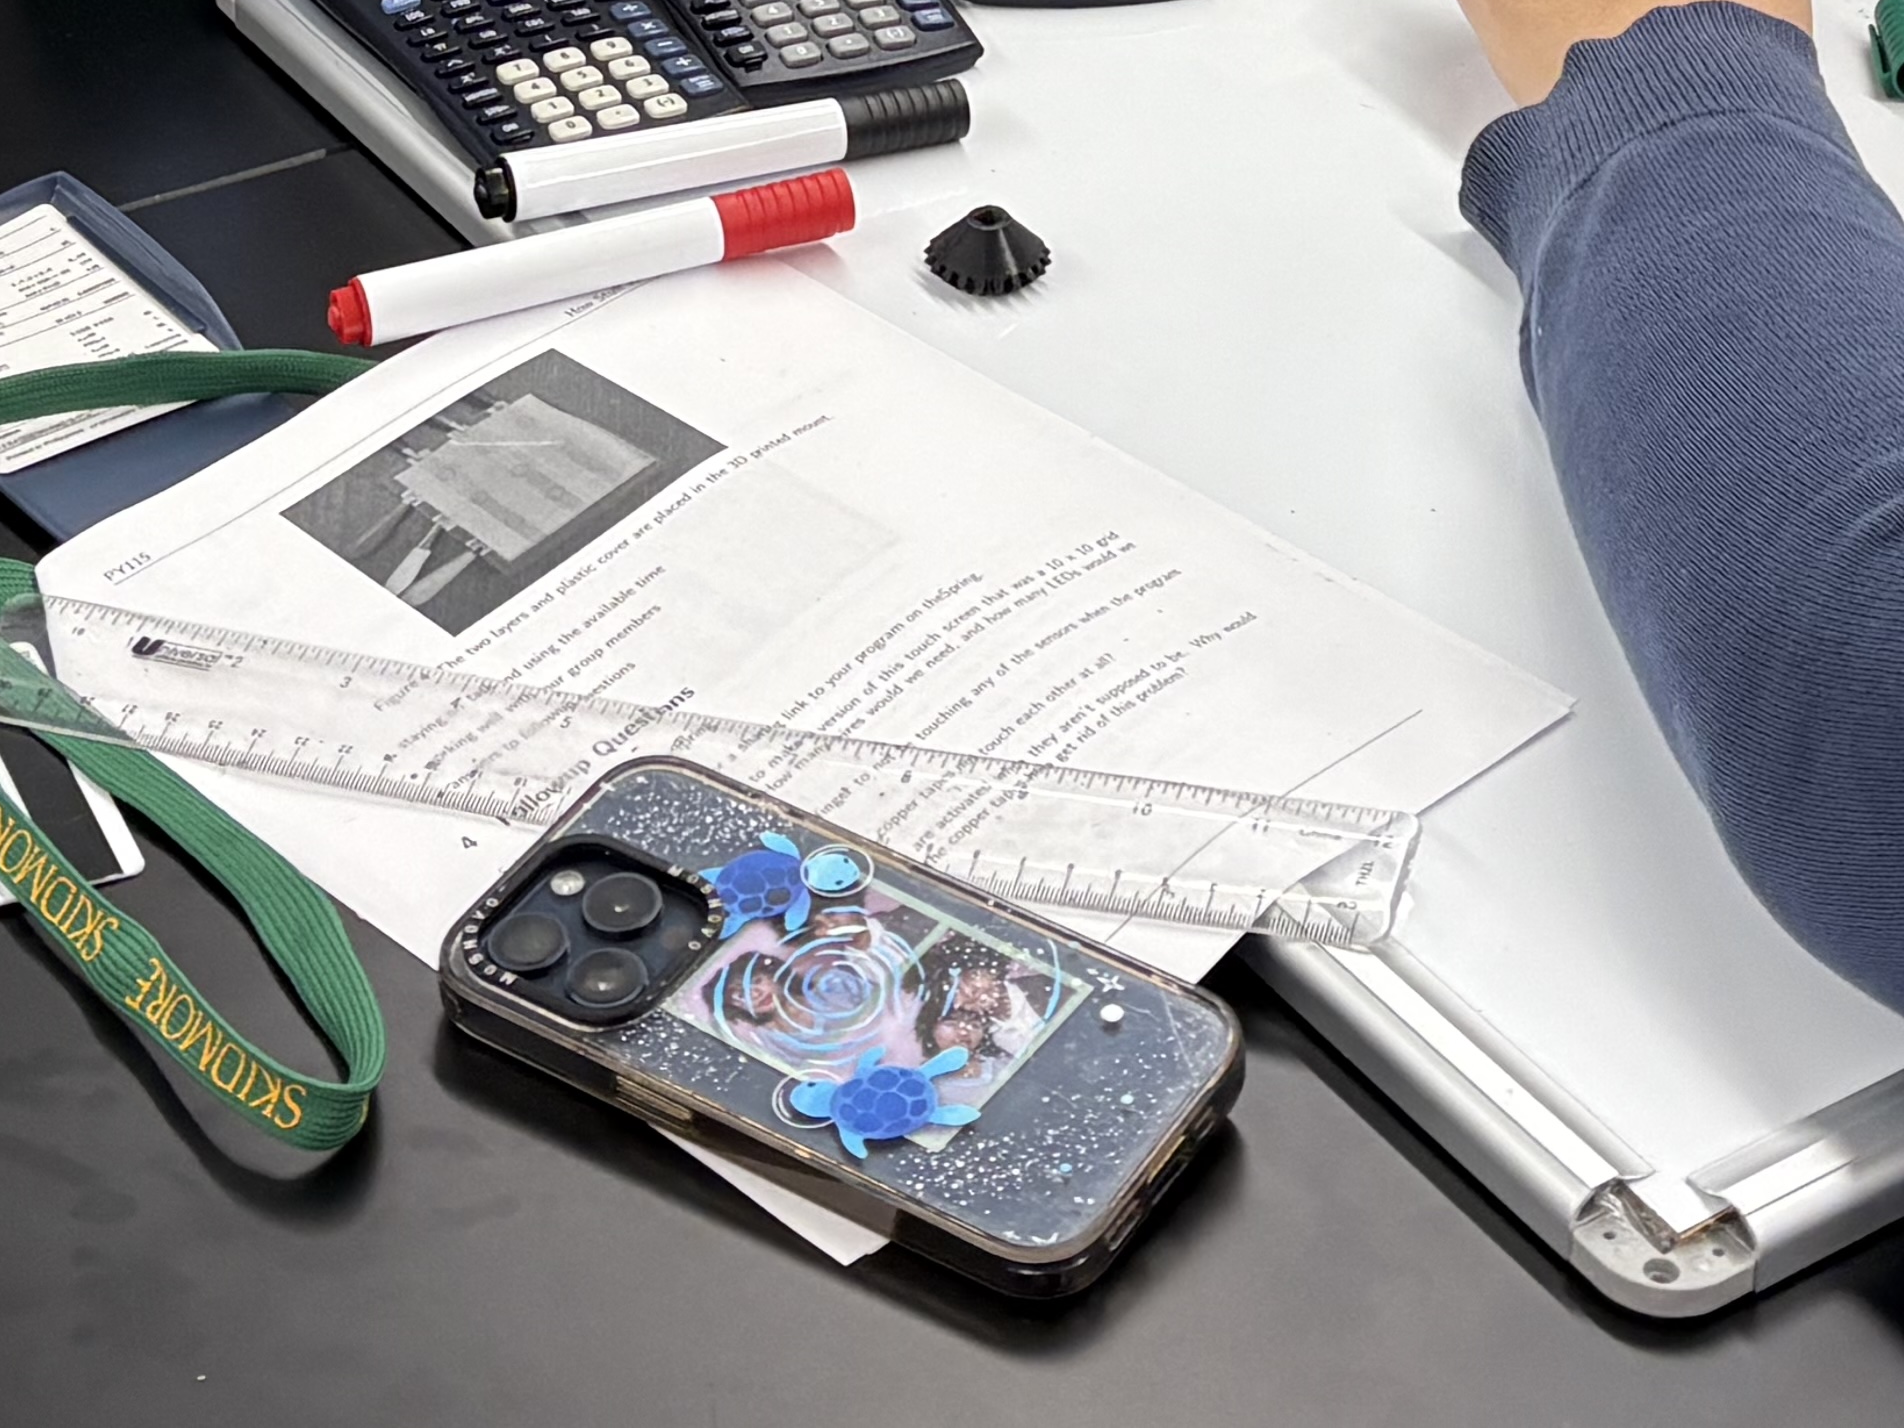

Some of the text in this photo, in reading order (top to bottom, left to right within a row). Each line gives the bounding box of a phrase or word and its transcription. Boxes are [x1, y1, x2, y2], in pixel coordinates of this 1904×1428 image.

[103, 550, 152, 583] PY115
[466, 635, 492, 655] two
[494, 610, 529, 639] layers
[530, 592, 555, 612] and
[556, 562, 598, 596] plastic
[597, 538, 631, 565] cover
[632, 522, 654, 540] are
[653, 492, 693, 526] placed
[689, 481, 707, 495] in
[706, 466, 729, 484] the
[727, 454, 749, 470] 3D
[750, 432, 793, 460] printed
[131, 635, 224, 665] Universal
[523, 642, 561, 674] using
[558, 625, 583, 646] the
[583, 588, 636, 629] available
[636, 564, 667, 590] time
[566, 645, 605, 678] group
[605, 603, 663, 649] members
[748, 769, 767, 784] to
[818, 697, 862, 732] version
[863, 680, 880, 697] of
[878, 662, 905, 683] this
[904, 633, 942, 661] touch
[943, 606, 982, 634] screen
[981, 587, 1010, 608] that
[1010, 574, 1036, 591] was
[1046, 554, 1066, 570] 10
[1076, 543, 1095, 557] 10
[781, 698, 808, 722] link
[808, 684, 826, 701] to
[825, 662, 854, 688] your
[854, 621, 906, 665] program
[906, 608, 924, 624] on
[866, 684, 905, 716] would
[904, 669, 925, 686] we
[961, 623, 986, 643] and
[986, 605, 1013, 626] how
[1014, 586, 1049, 610] many
[914, 694, 974, 742] touching
[970, 675, 997, 698] any
[996, 661, 1012, 678] of
[1011, 647, 1036, 666] the
[1035, 621, 1079, 650] sensors
[1079, 604, 1111, 625] when
[1110, 591, 1134, 608] the
[592, 685, 697, 758] Questions
[978, 725, 1017, 756] touch
[1015, 700, 1046, 726] each
[1045, 676, 1079, 704] other
[1079, 665, 1095, 681] at
[1027, 731, 1059, 758] they
[1059, 703, 1097, 733] aren't
[1096, 667, 1152, 706] supposed
[1077, 726, 1098, 745] rid
[1097, 713, 1112, 730] of
[1111, 698, 1138, 719] this
[1136, 665, 1190, 704] problem?
[125, 957, 306, 1129] SKIDMORE
